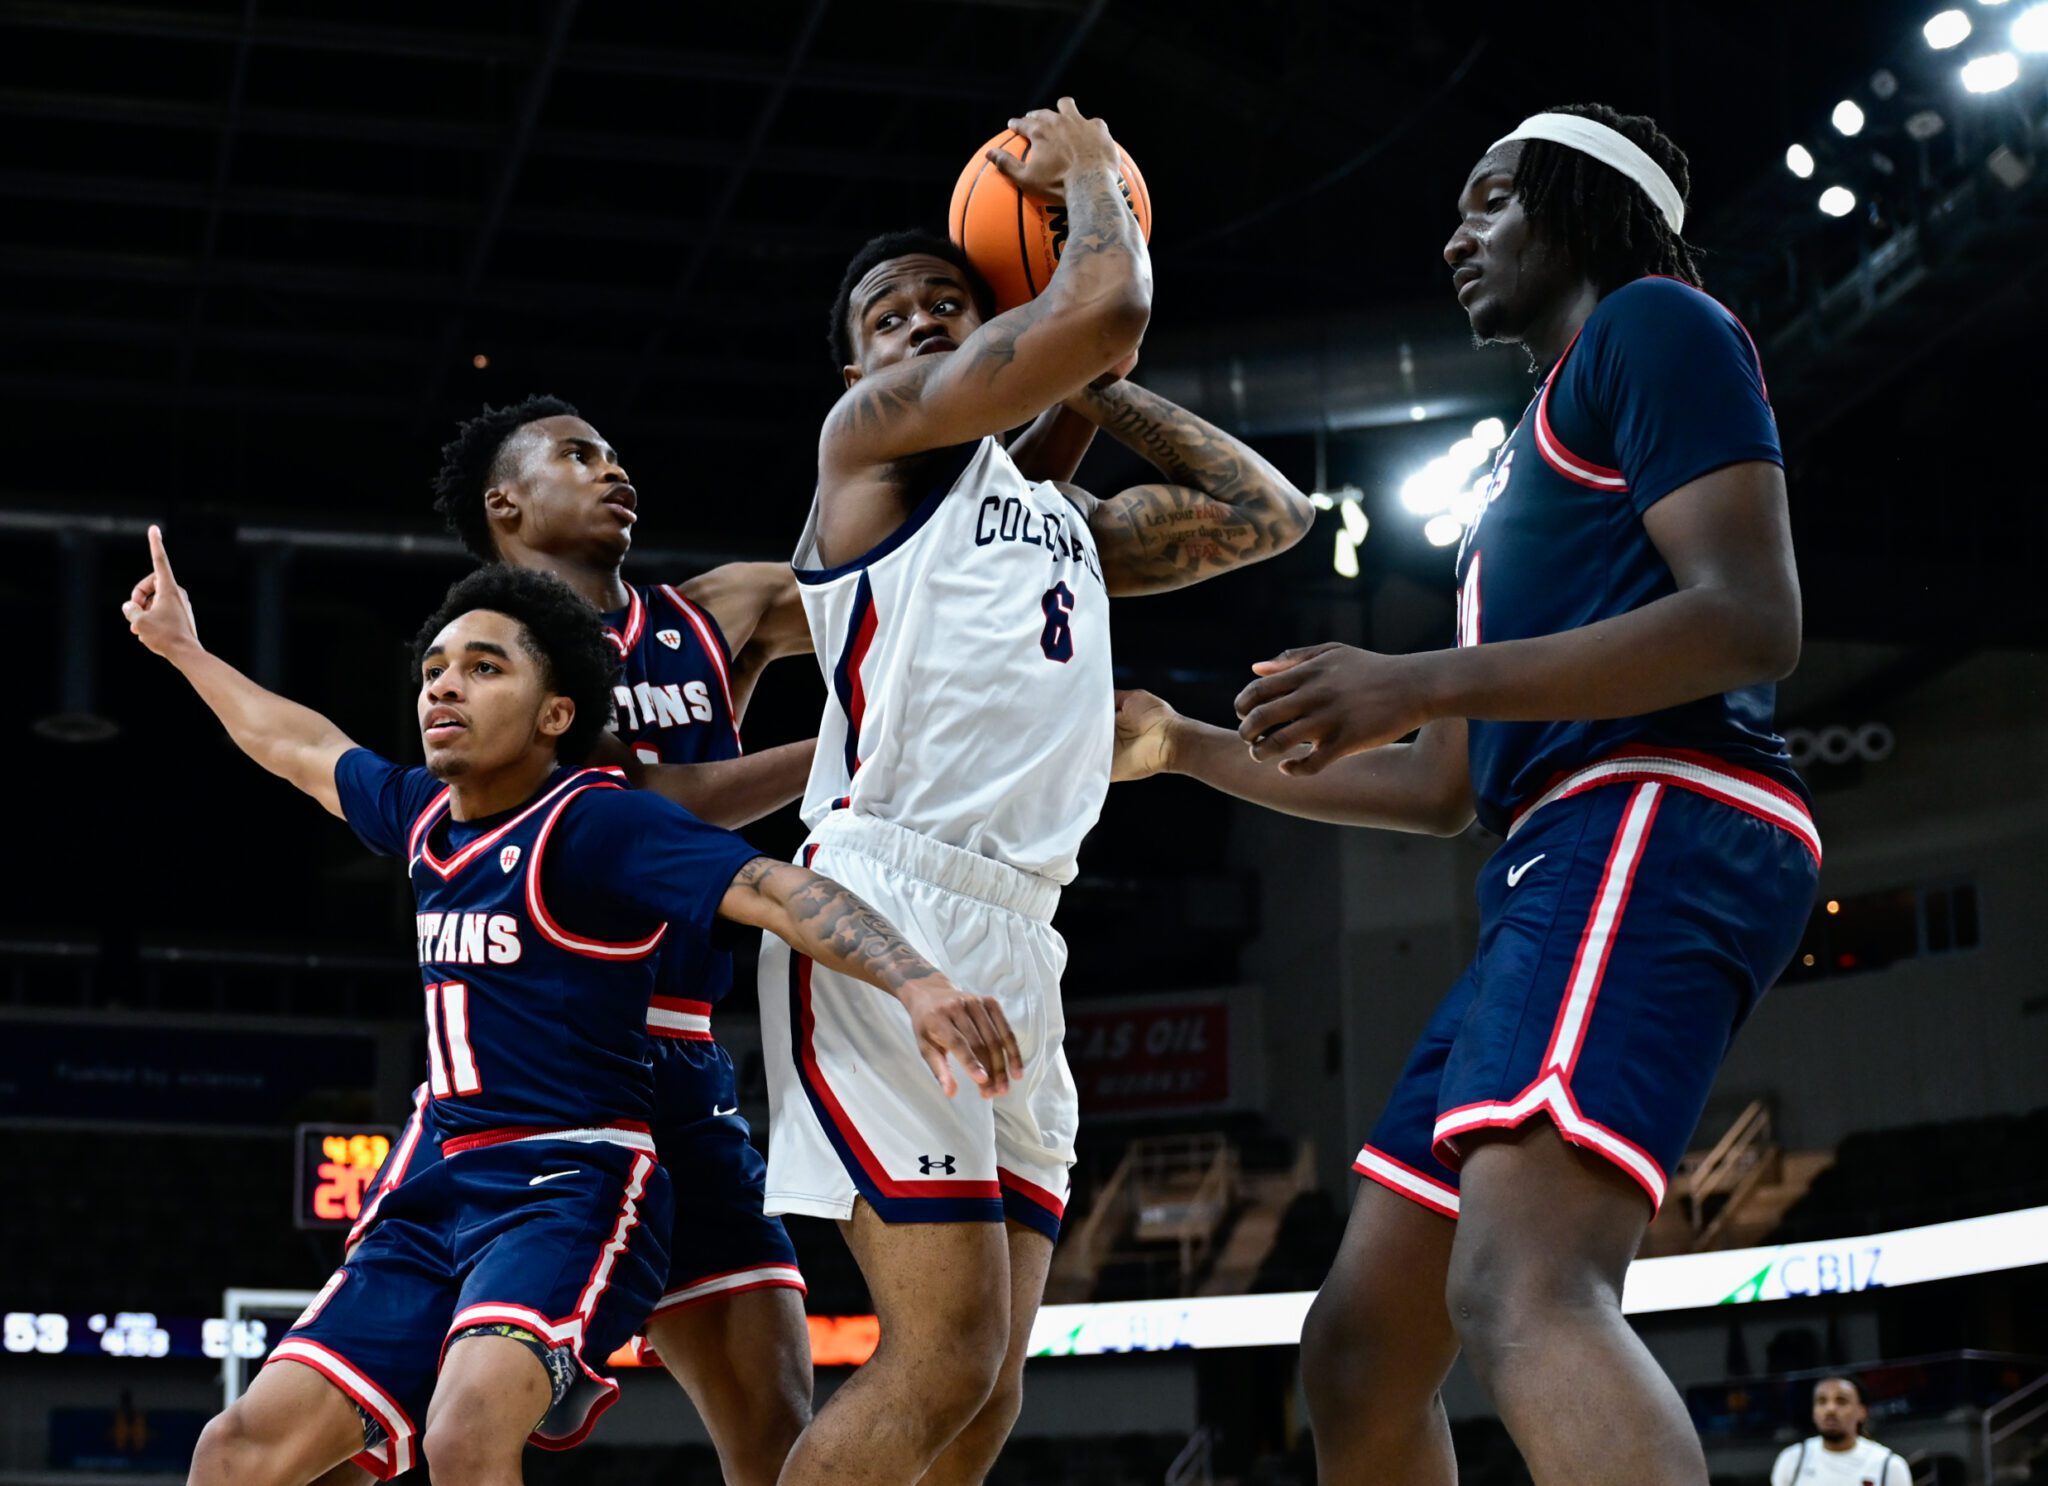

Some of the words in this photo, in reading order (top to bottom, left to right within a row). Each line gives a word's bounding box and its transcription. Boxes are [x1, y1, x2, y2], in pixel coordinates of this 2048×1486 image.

[1040, 580, 1075, 663] 6
[424, 980, 483, 1100] 11
[1146, 1014, 1208, 1057] OIL
[1780, 1246, 1886, 1301] CBIZ
